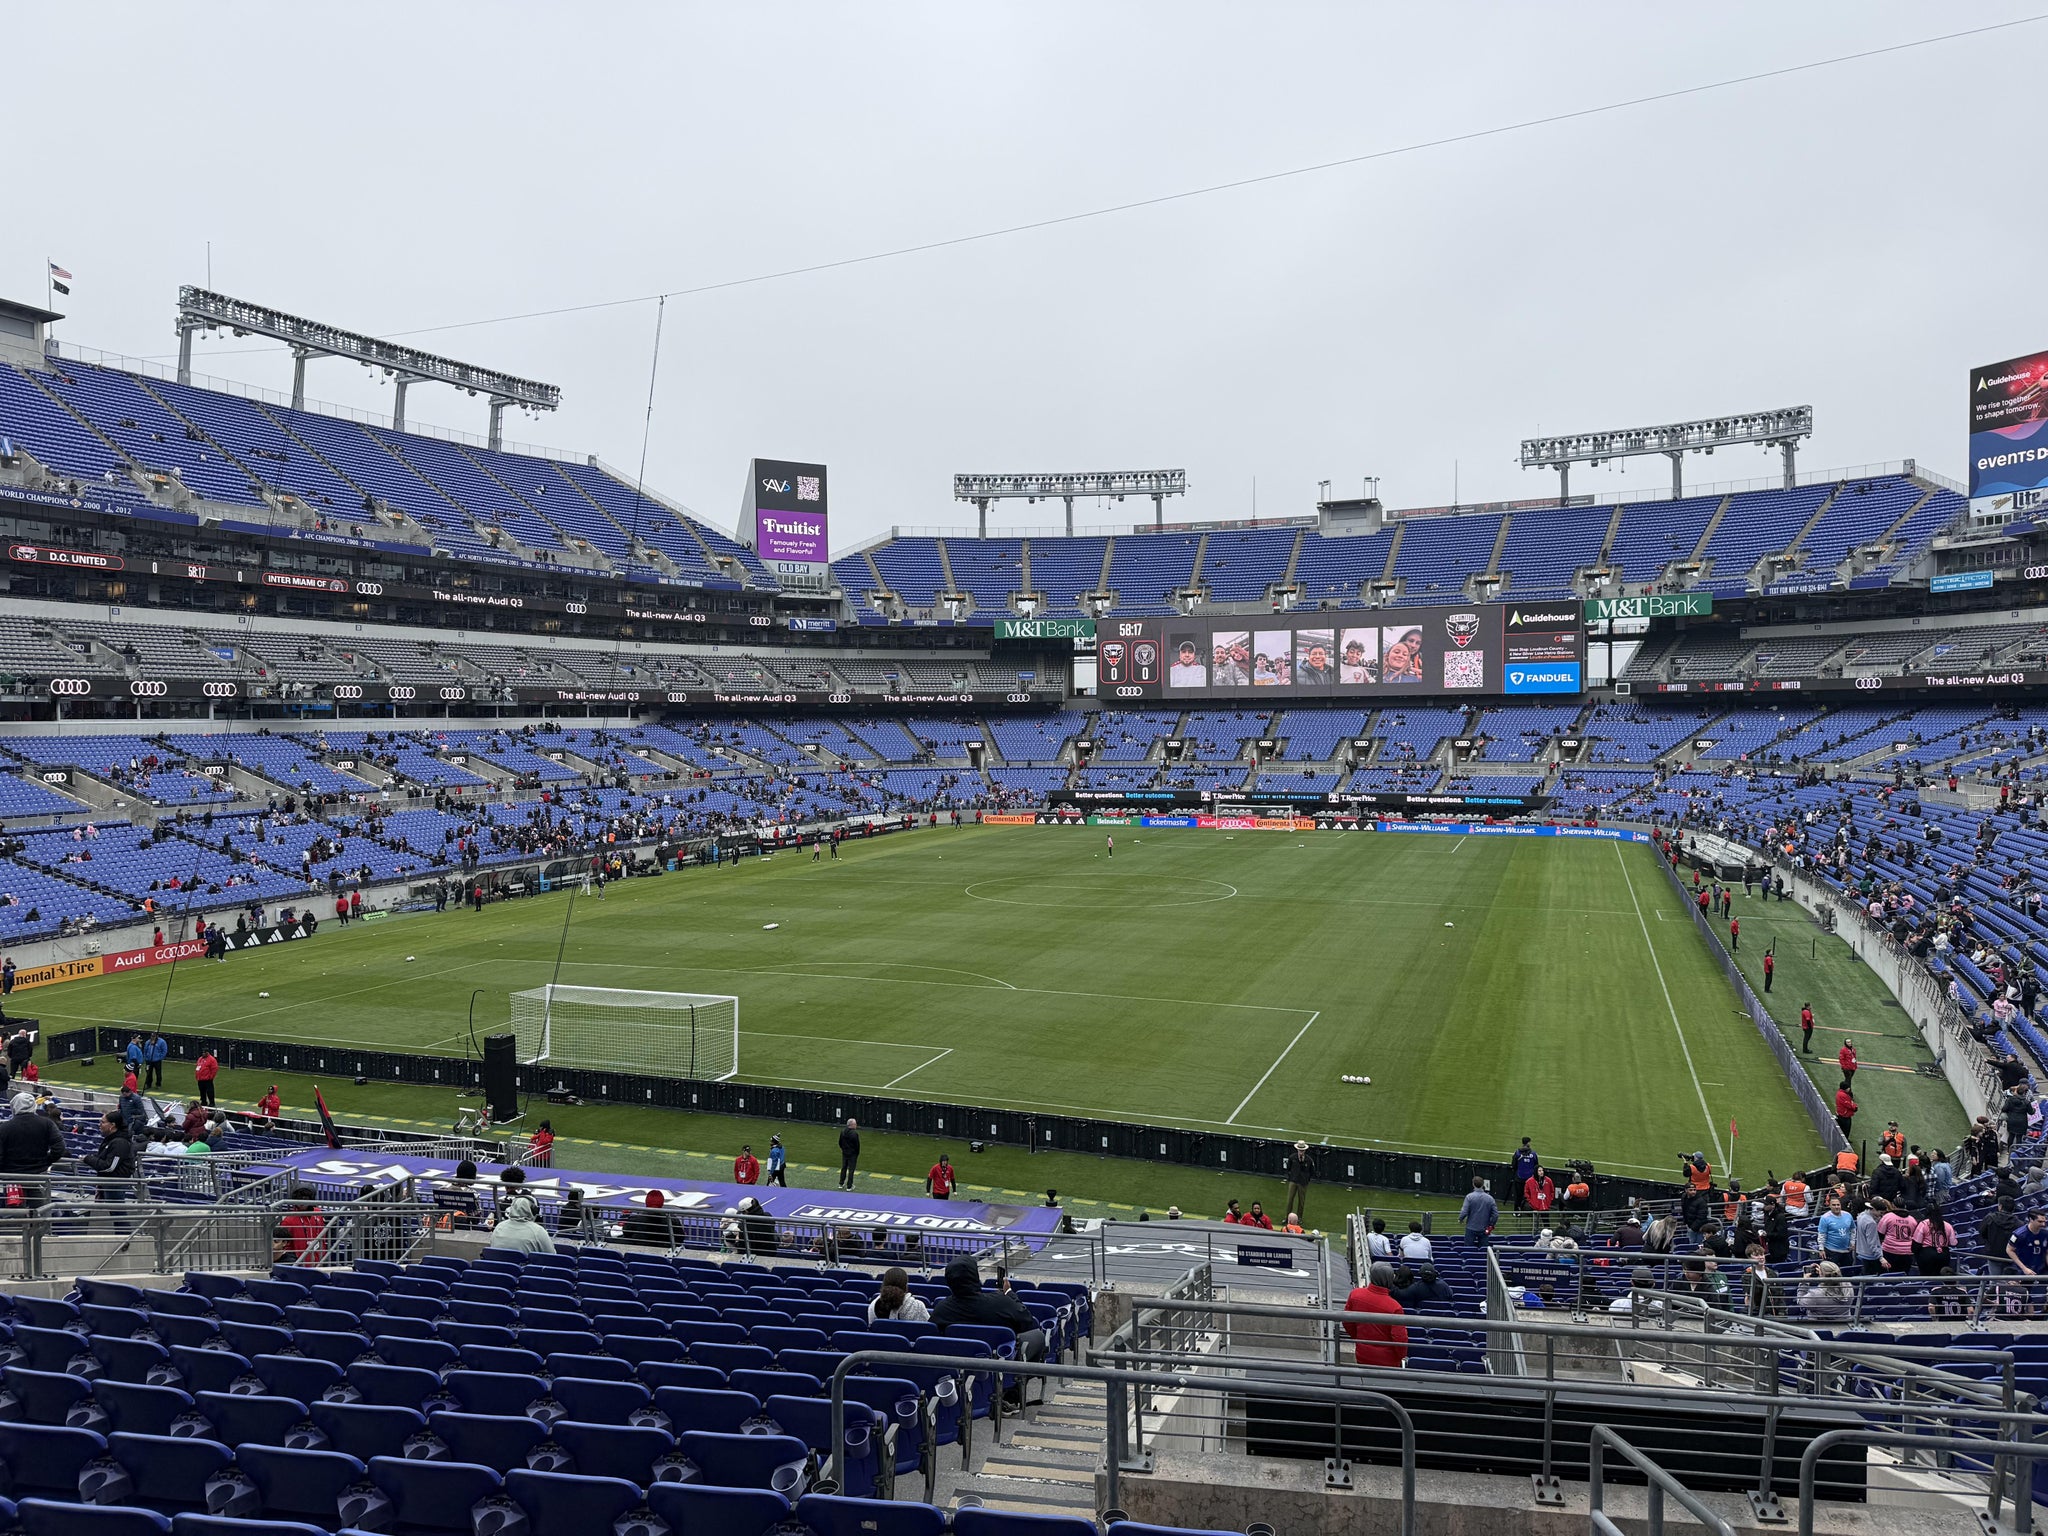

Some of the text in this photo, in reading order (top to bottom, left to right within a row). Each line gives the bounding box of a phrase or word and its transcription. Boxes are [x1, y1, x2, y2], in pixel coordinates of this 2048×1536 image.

[1987, 371, 2030, 386] Guidehouse
[1976, 404, 1987, 412] We
[2002, 394, 2031, 406] together
[1984, 410, 2005, 419] shape
[2005, 403, 2041, 414] tomorrow.
[26, 493, 69, 505] CHAMPIONS
[83, 501, 101, 510] 2000
[115, 506, 132, 515] 2012
[763, 518, 821, 536] Fruitist
[315, 535, 346, 544] CHAMPIONS
[769, 538, 798, 547] Famously
[49, 552, 107, 566] D.C. UNITED
[188, 565, 206, 578] 58:17
[780, 564, 808, 573] OLD BAY
[268, 574, 327, 589] INTER MIAMI CF
[433, 590, 523, 609] The all-new Audi Q3
[1596, 595, 1699, 618] M&T Bank
[625, 609, 706, 622] The all-new Audi Q3
[1522, 613, 1575, 622] Guidehouse
[1003, 620, 1086, 637] M&T Bank
[1119, 623, 1142, 636] 58:17
[1110, 667, 1149, 680] 0 0
[1526, 673, 1574, 683] FANDUEL
[1925, 673, 2024, 686] The all-new Audi Q3
[1723, 683, 1744, 691] UNITED
[1781, 681, 1800, 689] UNITED
[557, 690, 640, 701] The all-new Audi Q3
[714, 693, 797, 703] The all-new Audi Q3
[883, 694, 973, 702] The all-new Audi Q3
[1149, 818, 1189, 826] ticketmaster
[115, 953, 146, 968] Audi
[66, 962, 95, 976] Tire
[1894, 1224, 1912, 1240] 10
[1942, 1297, 2022, 1316] 10 10
